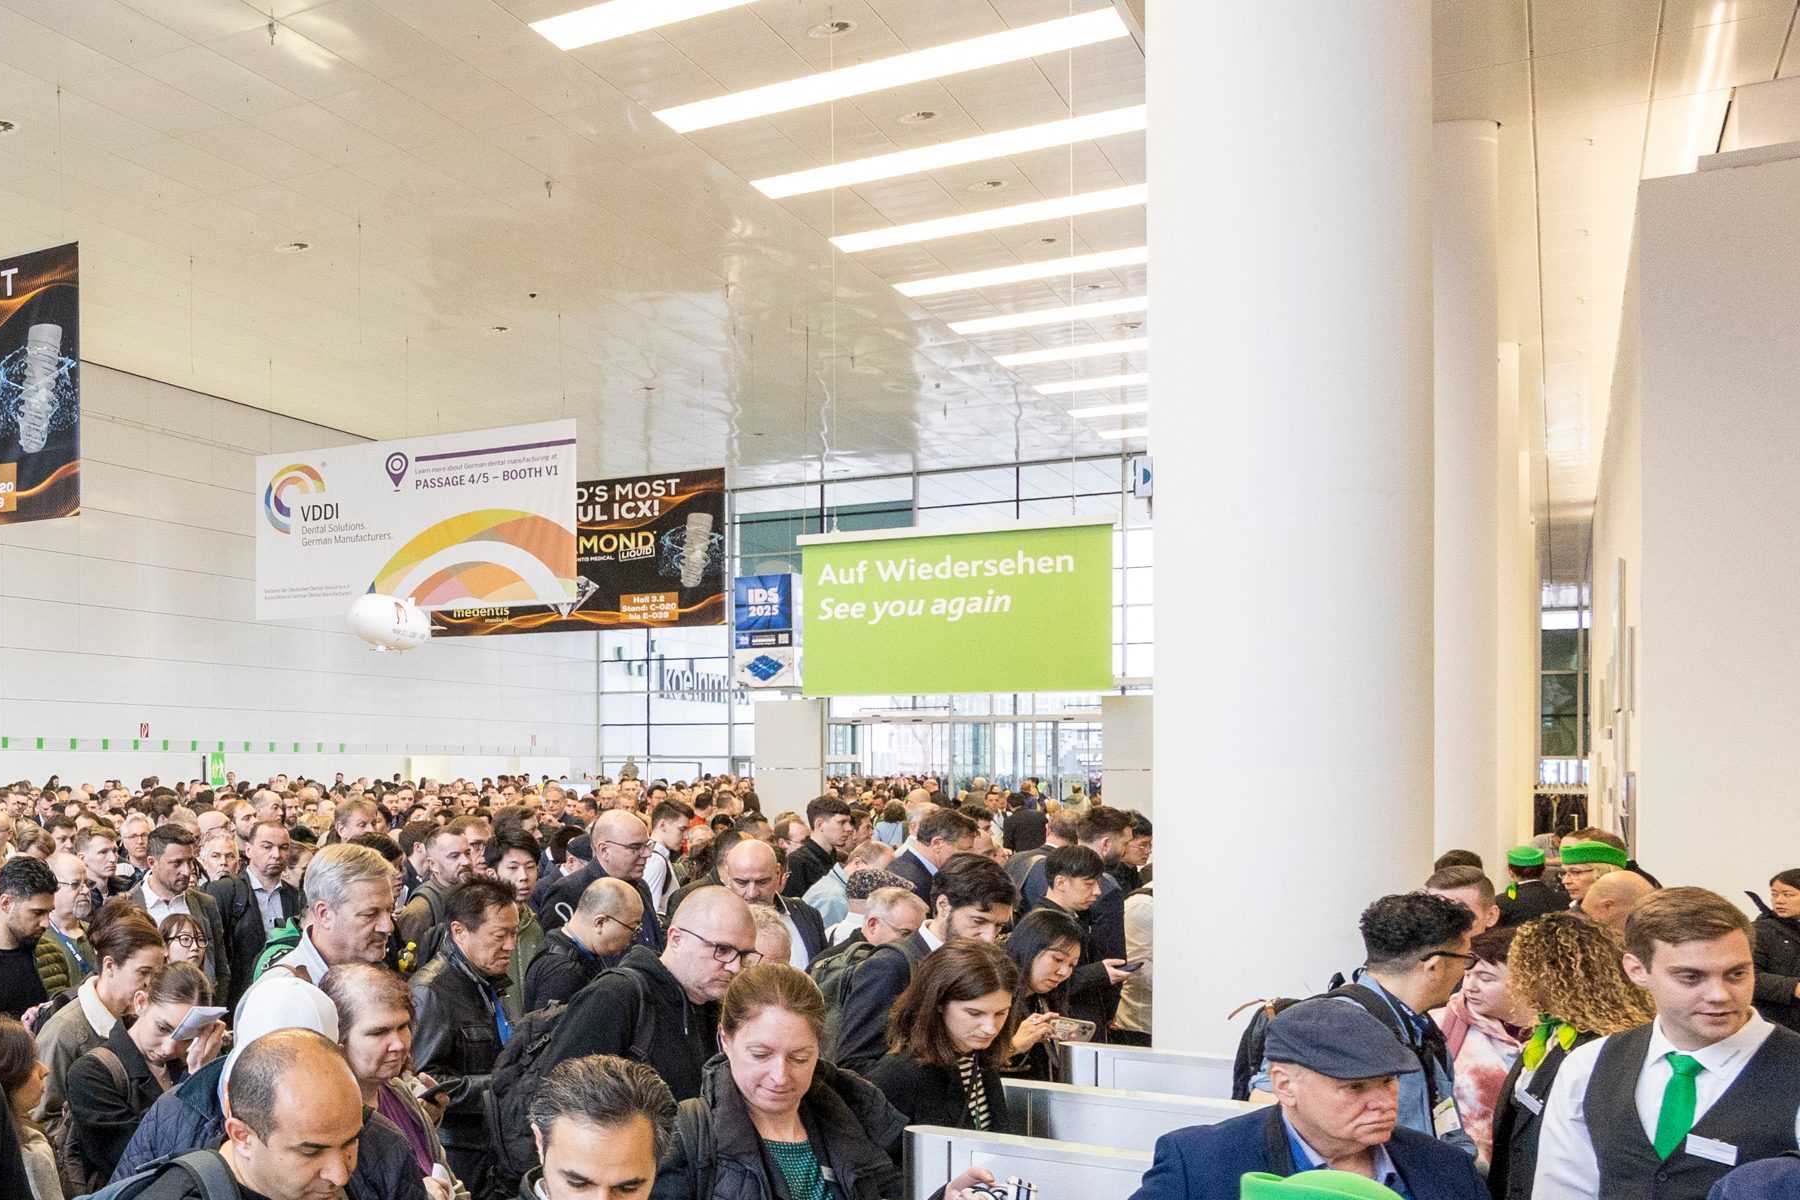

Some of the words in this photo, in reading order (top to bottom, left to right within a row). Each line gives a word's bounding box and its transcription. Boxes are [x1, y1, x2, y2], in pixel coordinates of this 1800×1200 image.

[415, 474, 465, 490] PASSAGE
[468, 472, 489, 485] 4/5
[502, 467, 542, 481] BOOTH
[545, 464, 559, 476] V1
[615, 478, 680, 501] MOST
[301, 502, 339, 522] VDDI
[613, 499, 660, 520] ICX!
[301, 524, 326, 535] Dental
[818, 559, 867, 587] Auf
[876, 549, 1075, 584] Wiedersehen
[748, 588, 779, 603] IDS
[818, 597, 867, 622] See
[868, 598, 924, 625] you
[931, 585, 1012, 622] again
[748, 605, 779, 617] 2025
